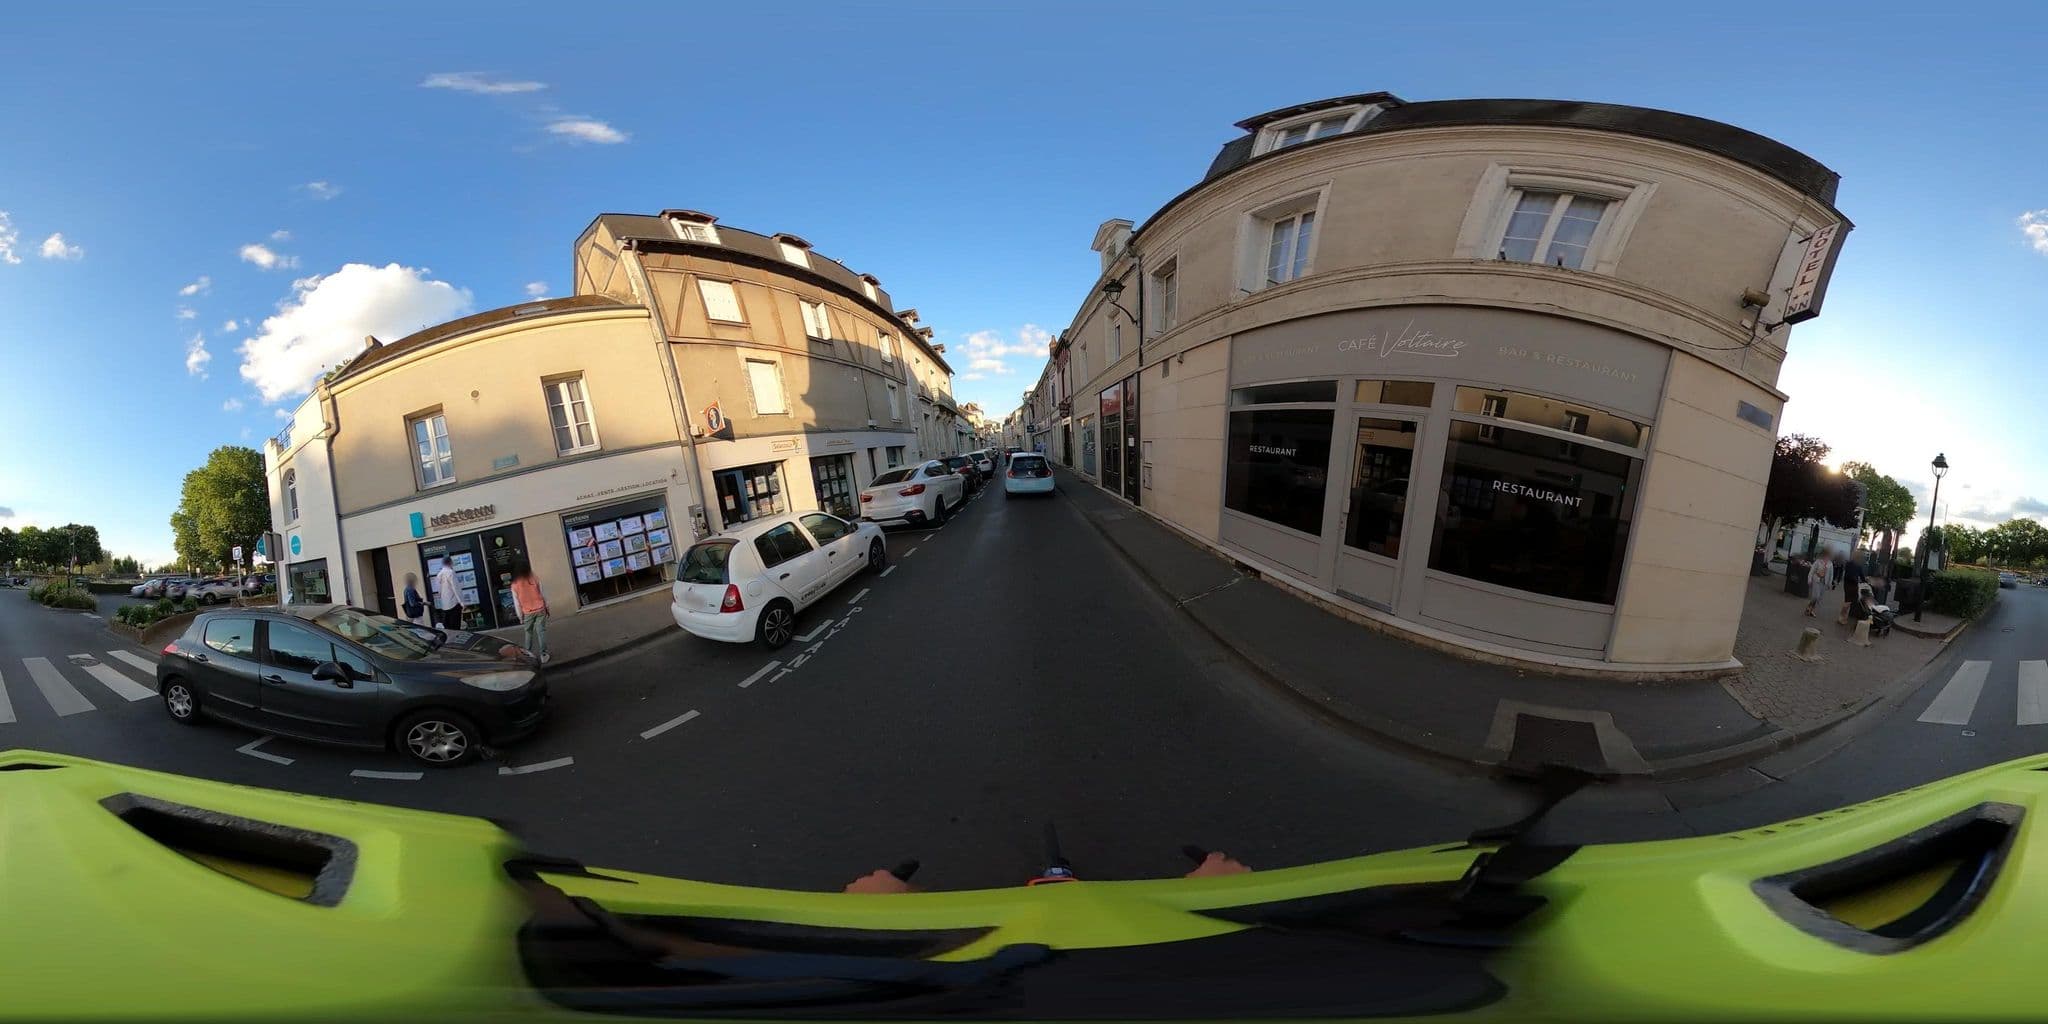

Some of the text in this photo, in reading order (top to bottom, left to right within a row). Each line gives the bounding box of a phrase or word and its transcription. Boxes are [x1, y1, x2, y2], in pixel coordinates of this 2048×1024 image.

[1798, 228, 1834, 287] HOTEL
[1338, 313, 1466, 359] CAFÉ Voltaire
[1497, 346, 1528, 360] BAR
[1546, 352, 1641, 385] RESTAURANT
[1249, 444, 1297, 457] RESTAURANT
[1492, 479, 1585, 508] RESTAURANT
[769, 606, 864, 684] PAYANT
